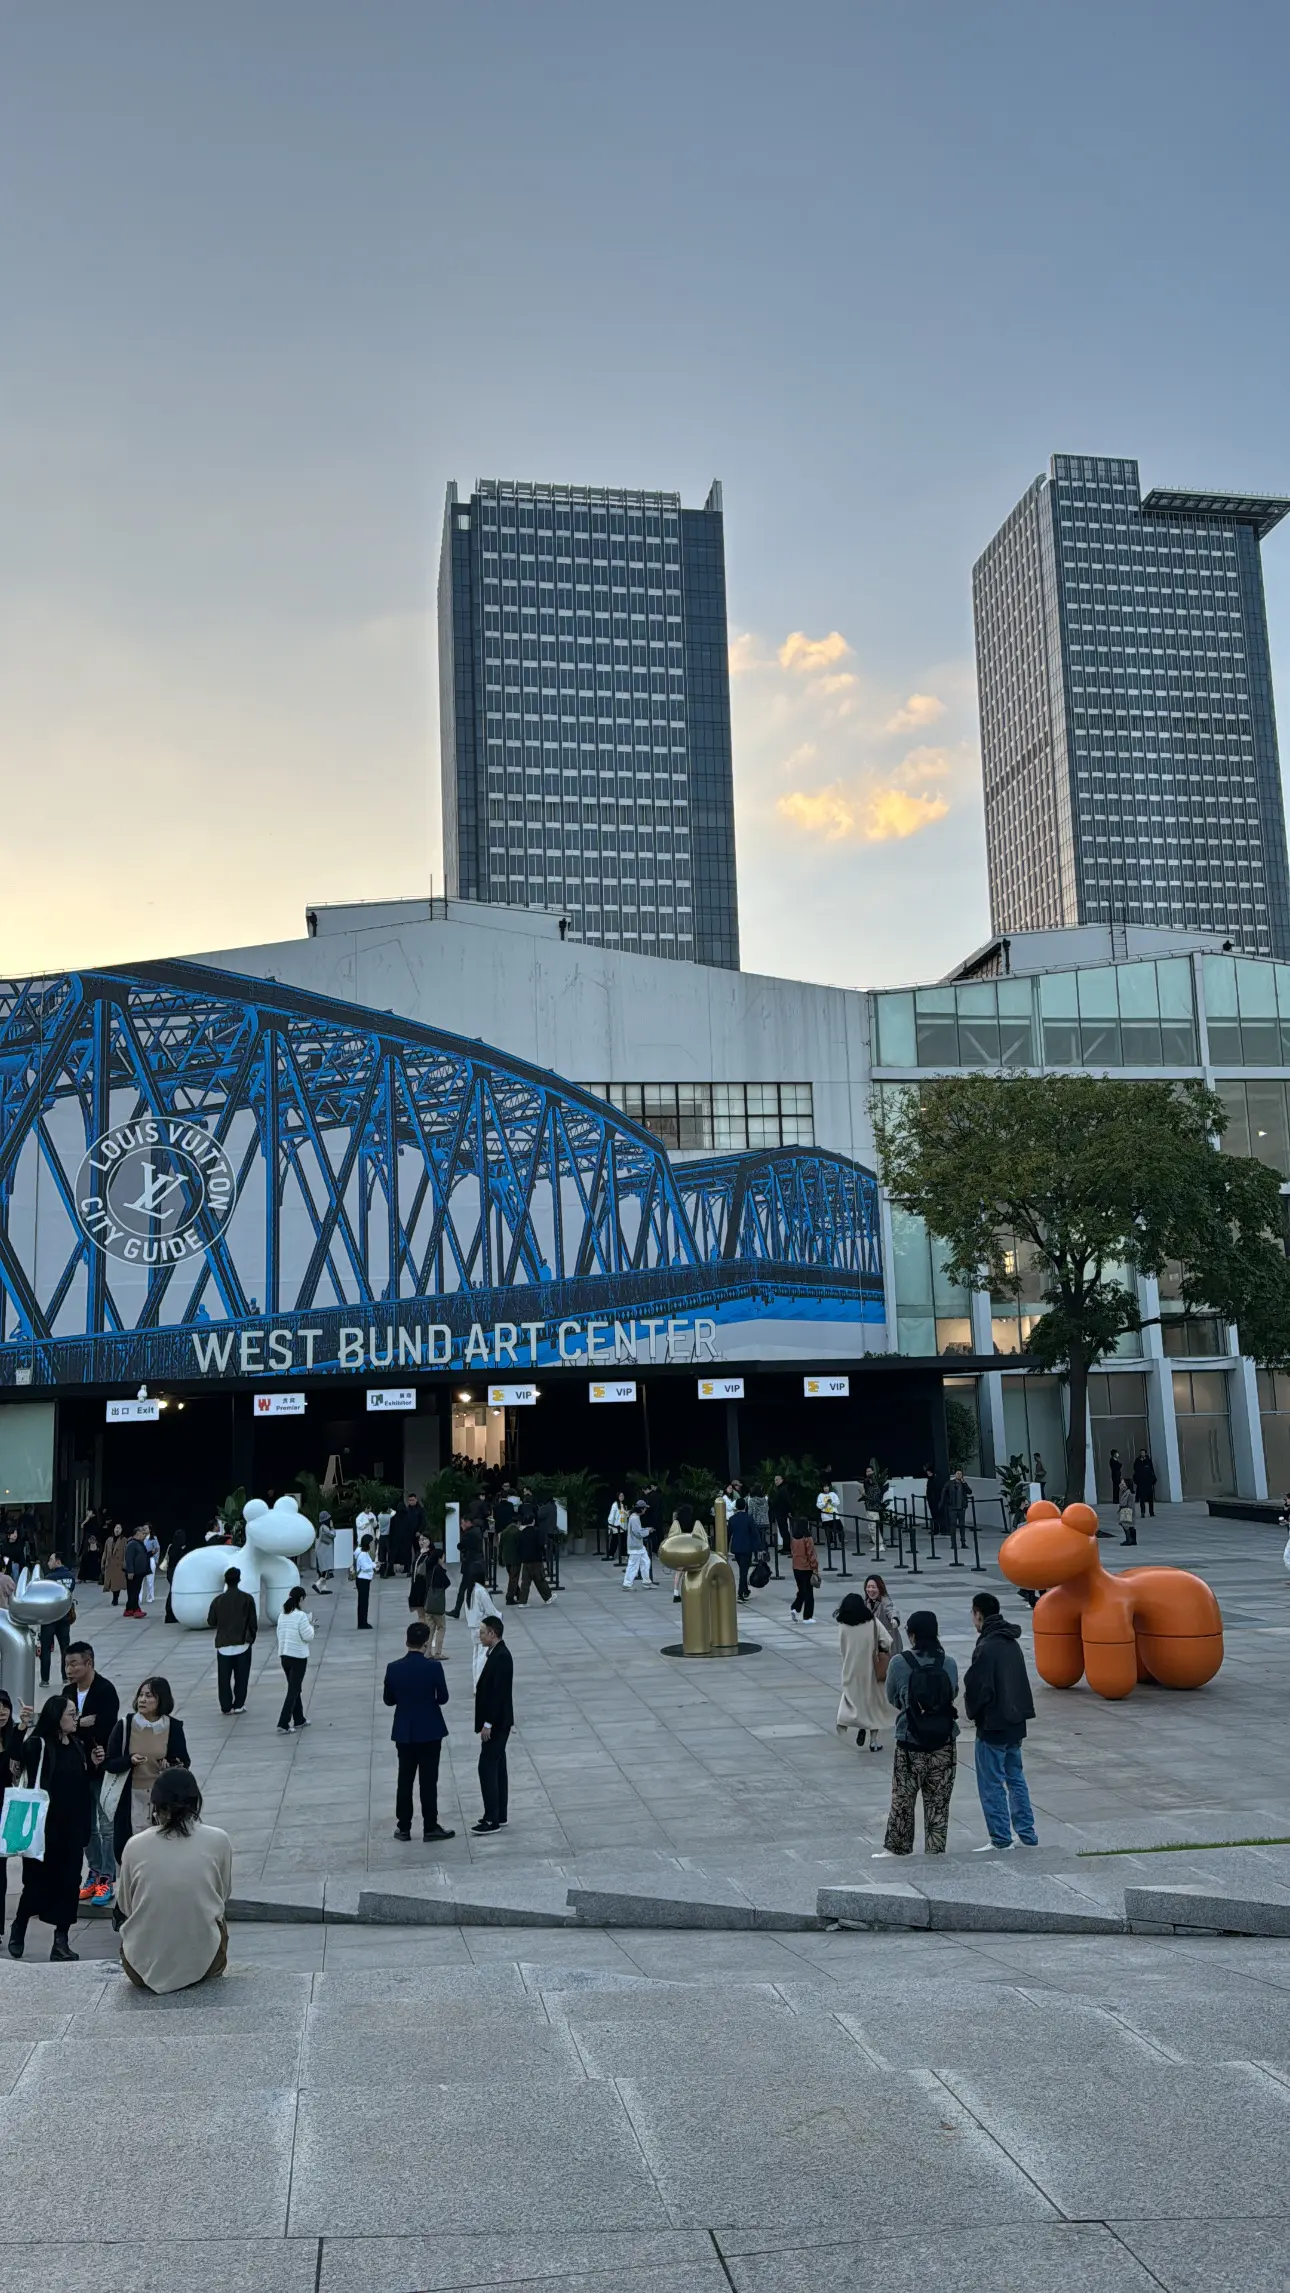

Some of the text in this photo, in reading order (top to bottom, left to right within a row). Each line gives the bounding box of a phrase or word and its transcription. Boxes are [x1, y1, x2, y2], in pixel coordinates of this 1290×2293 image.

[88, 1122, 231, 1211] LOUIS VUITTON
[81, 1196, 204, 1262] CITY GUIDE
[191, 1318, 718, 1374] WEST BUND ART CENTER
[724, 1384, 740, 1393] VIP
[829, 1382, 845, 1391] VIP
[515, 1391, 532, 1400] VIP
[616, 1388, 632, 1396] VIP
[111, 1406, 154, 1416] 出口 Exit
